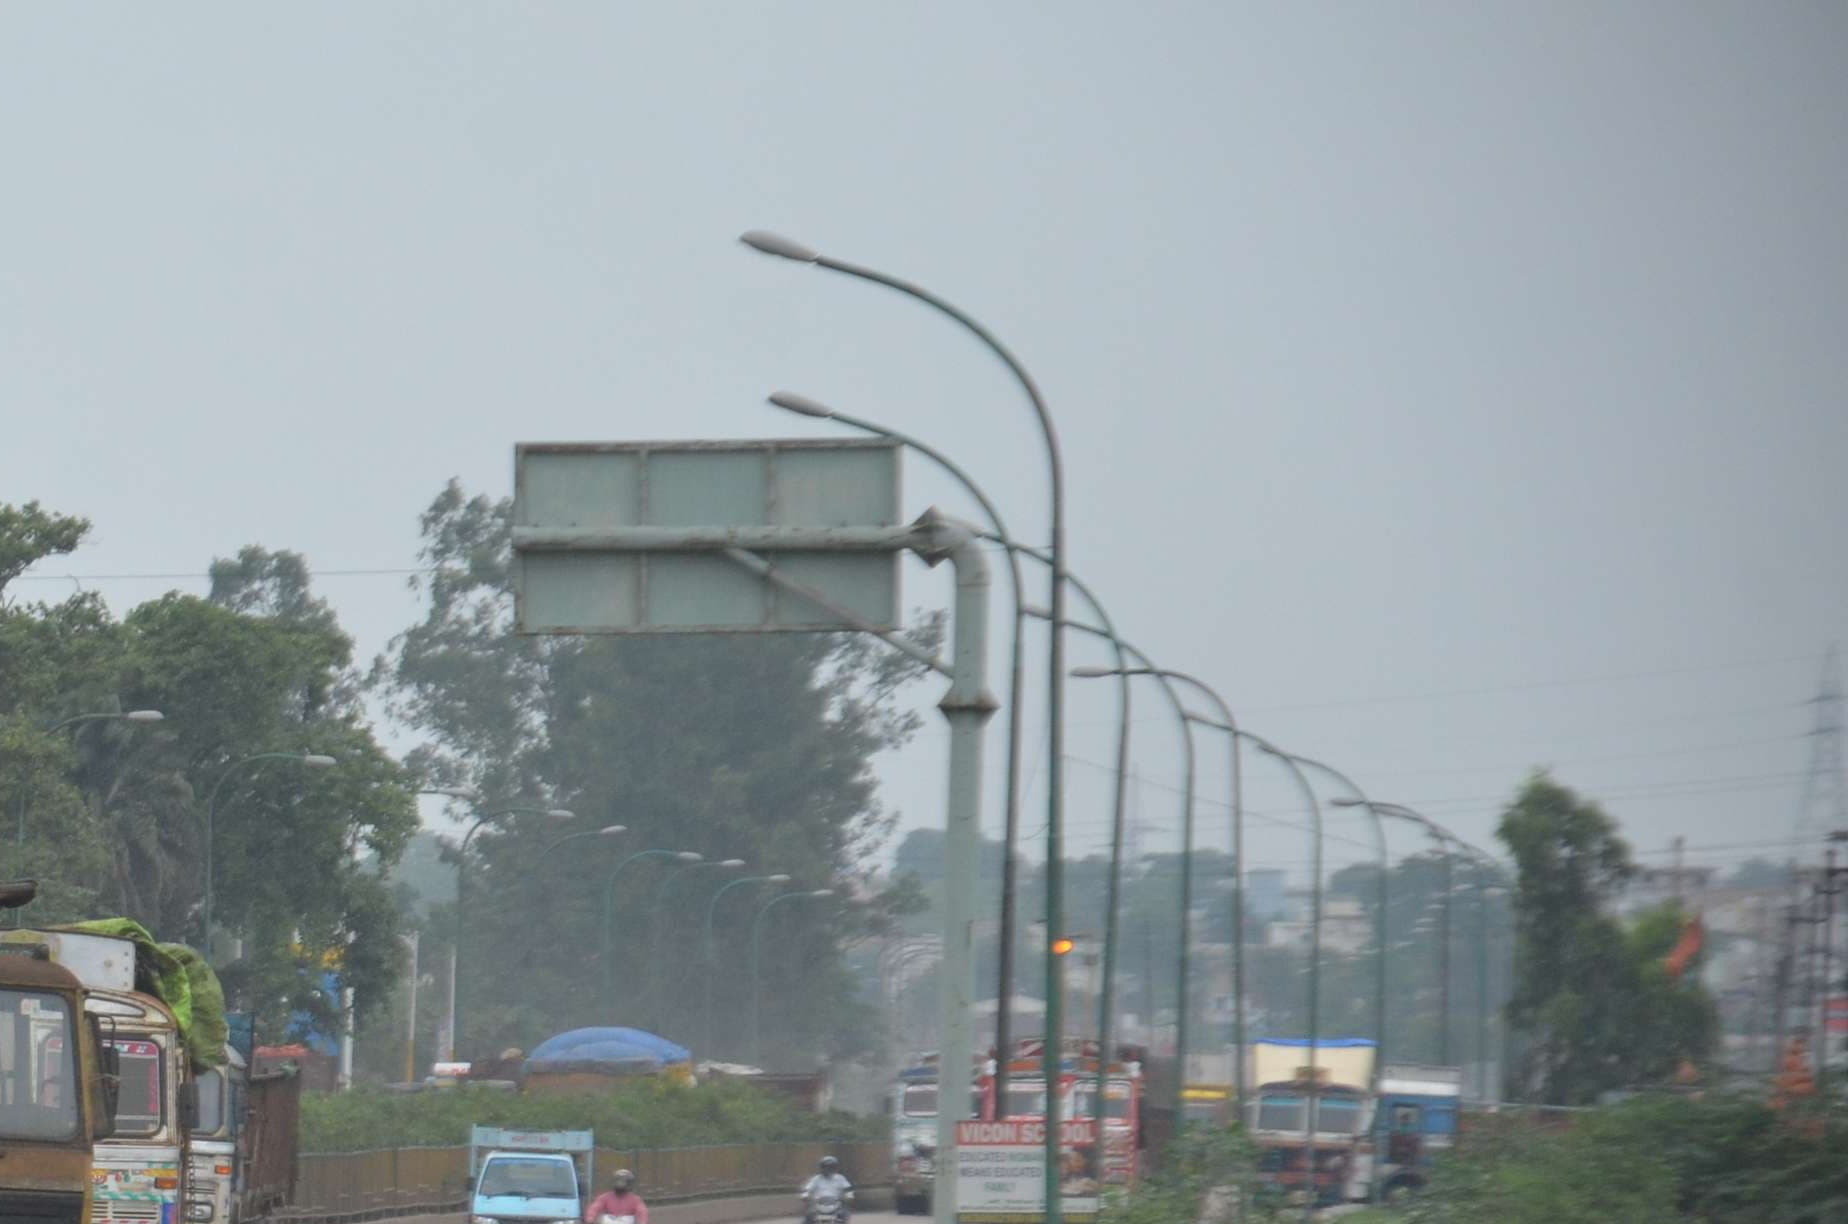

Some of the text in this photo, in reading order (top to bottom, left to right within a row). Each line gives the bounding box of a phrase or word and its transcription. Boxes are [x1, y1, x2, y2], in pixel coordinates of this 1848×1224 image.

[960, 1122, 1095, 1143] VICON SCOOL
[994, 1166, 1042, 1178] EDUCATED
